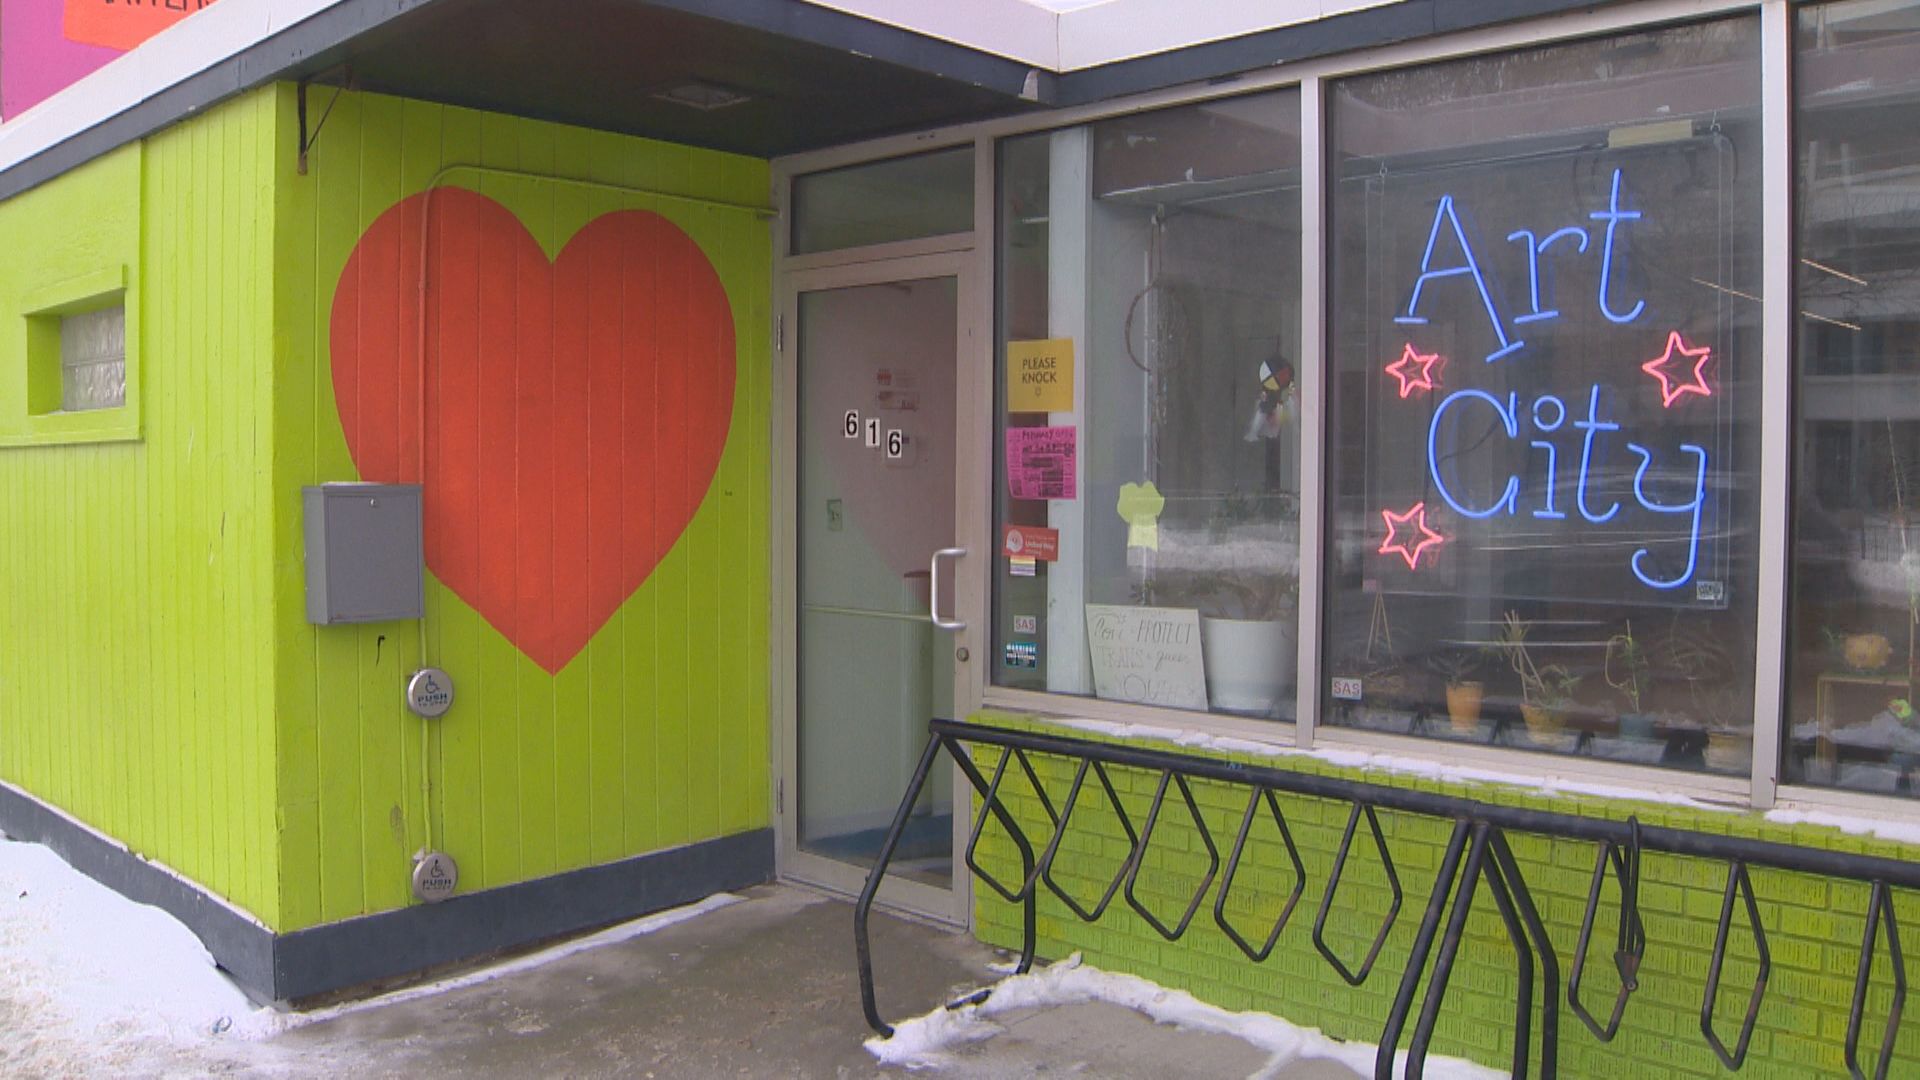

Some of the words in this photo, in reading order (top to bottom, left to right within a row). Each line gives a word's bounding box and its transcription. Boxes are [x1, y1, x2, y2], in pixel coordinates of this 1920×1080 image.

[1393, 168, 1646, 363] Art
[1022, 357, 1057, 370] PLEASE
[1022, 371, 1057, 384] KNOCK
[1427, 384, 1708, 590] City
[1333, 680, 1361, 696] SAS
[417, 692, 447, 702] PUSH
[422, 879, 452, 887] PUSH
